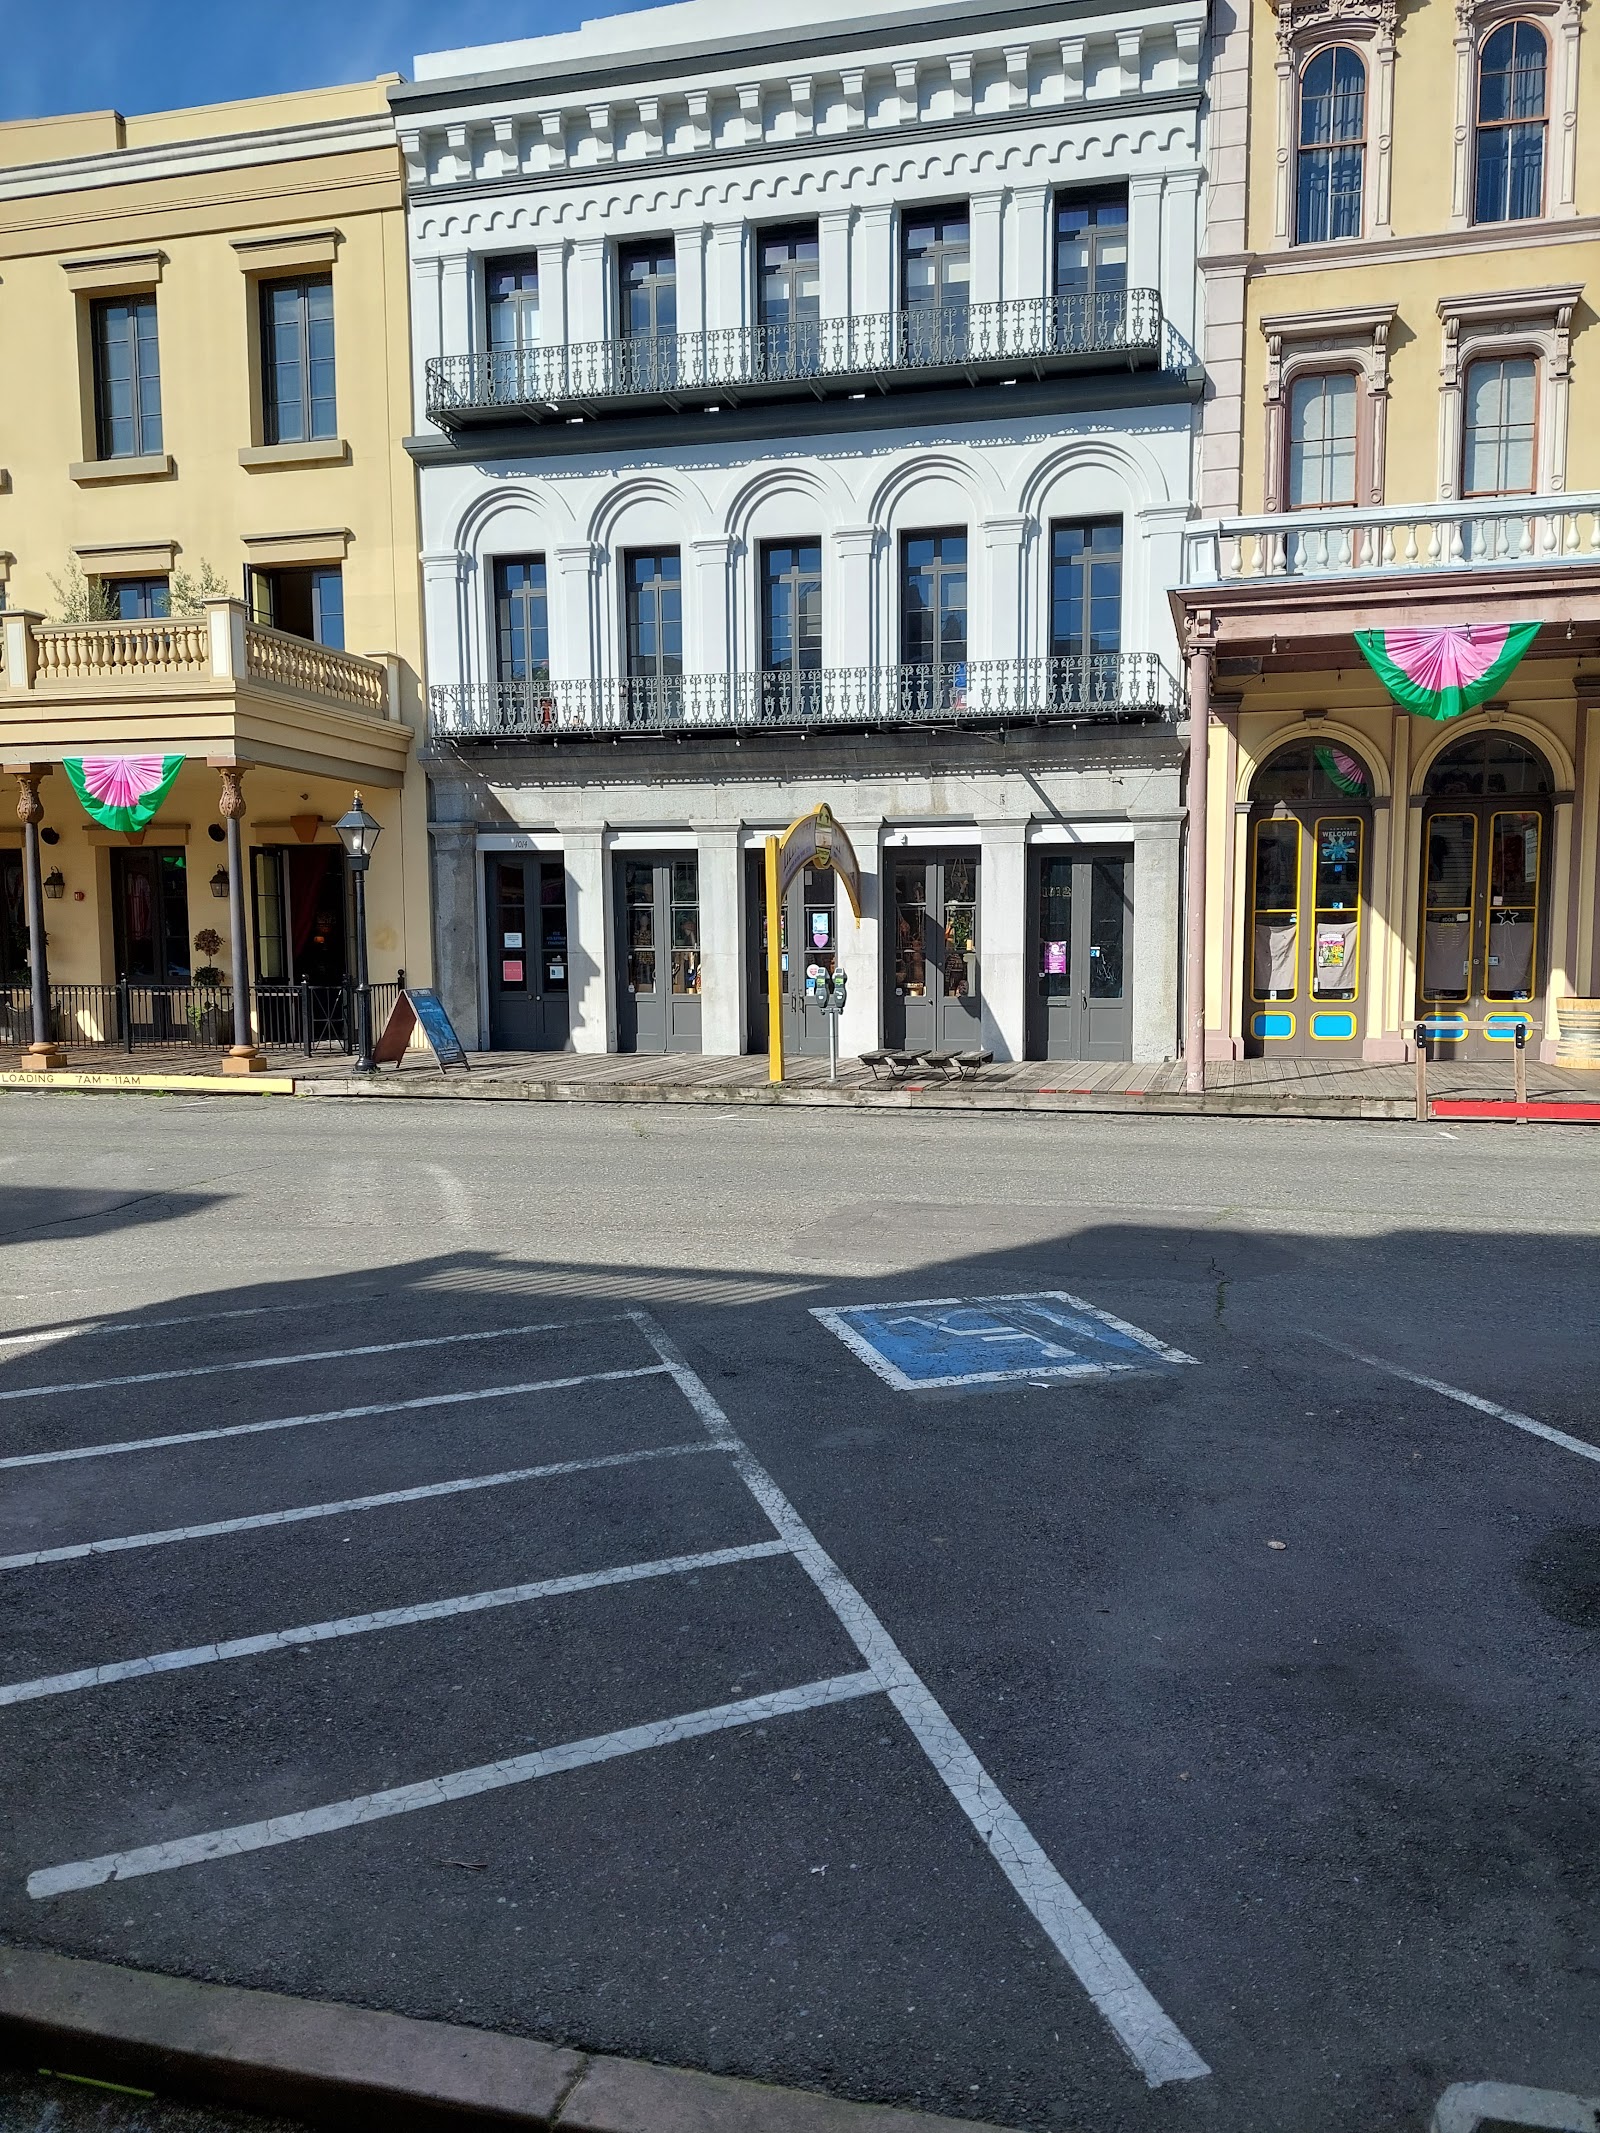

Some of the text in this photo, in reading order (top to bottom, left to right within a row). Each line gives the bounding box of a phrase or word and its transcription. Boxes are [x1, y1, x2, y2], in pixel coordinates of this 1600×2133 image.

[1042, 886, 1072, 898] 1012
[2, 1074, 54, 1083] LOADING
[75, 1075, 101, 1084] 7AM
